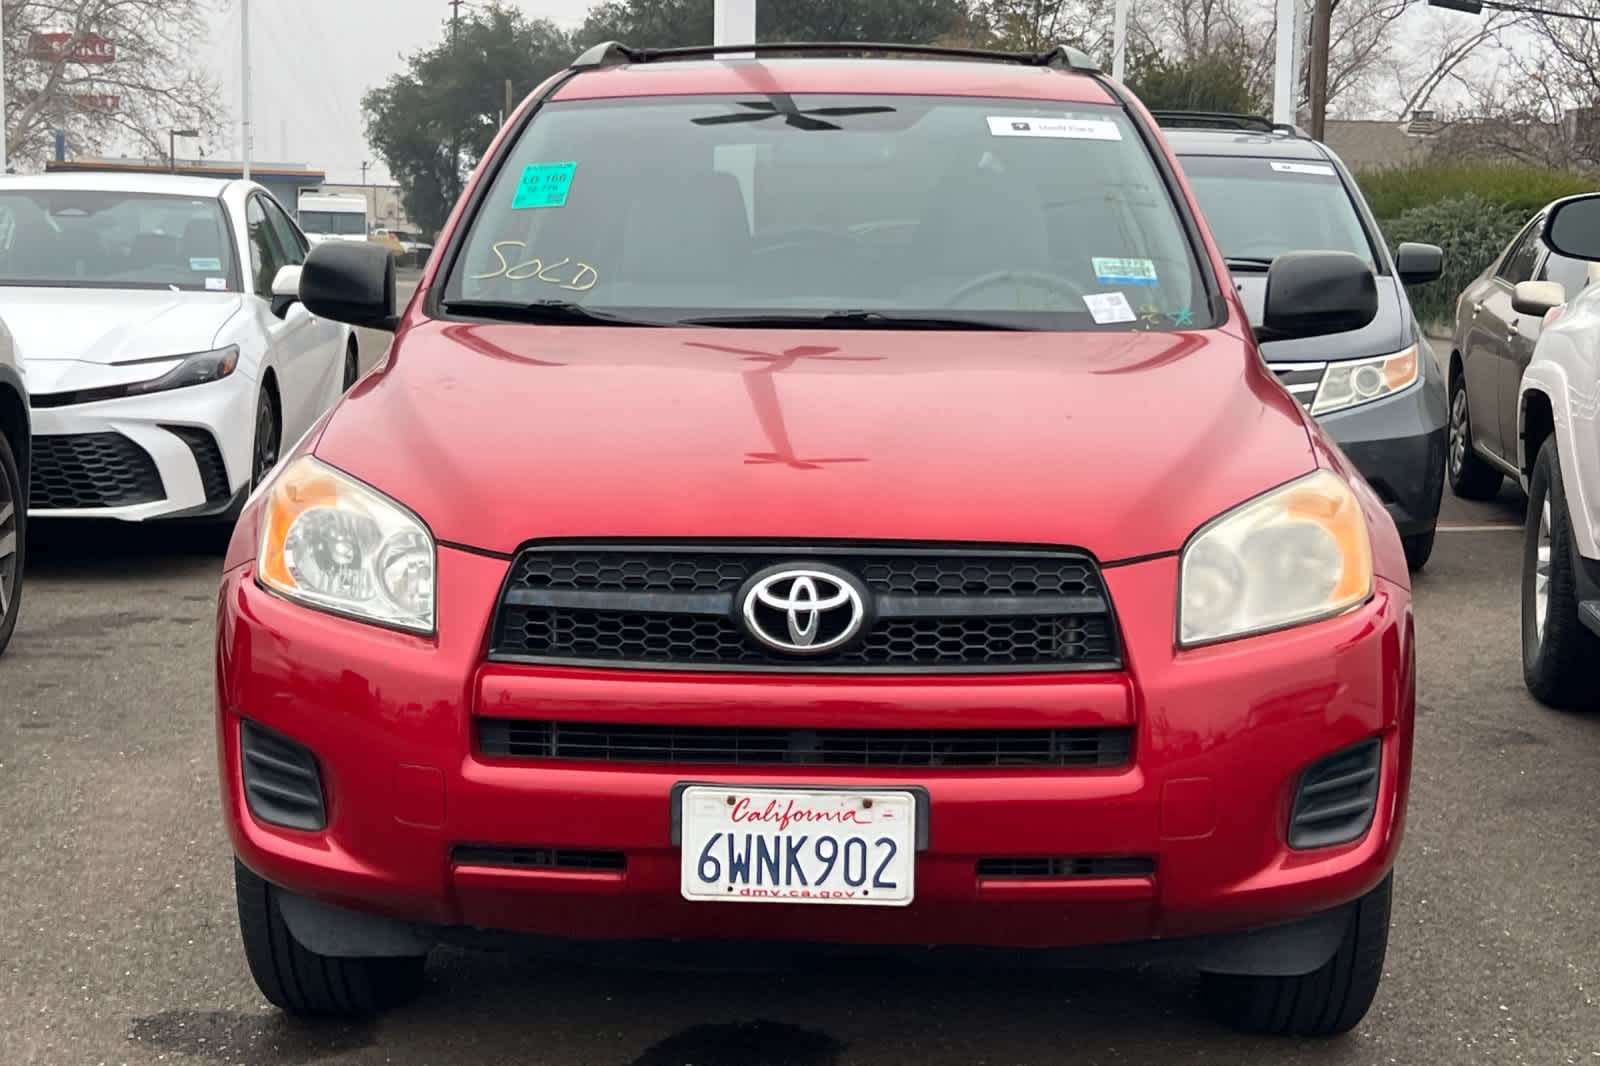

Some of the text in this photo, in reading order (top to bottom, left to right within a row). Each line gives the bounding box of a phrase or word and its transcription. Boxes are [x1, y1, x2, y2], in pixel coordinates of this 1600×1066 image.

[470, 240, 598, 291] SOLD
[732, 798, 872, 830] California
[697, 832, 898, 889] 6WNK902
[740, 887, 856, 899] dmv.ca.gov
